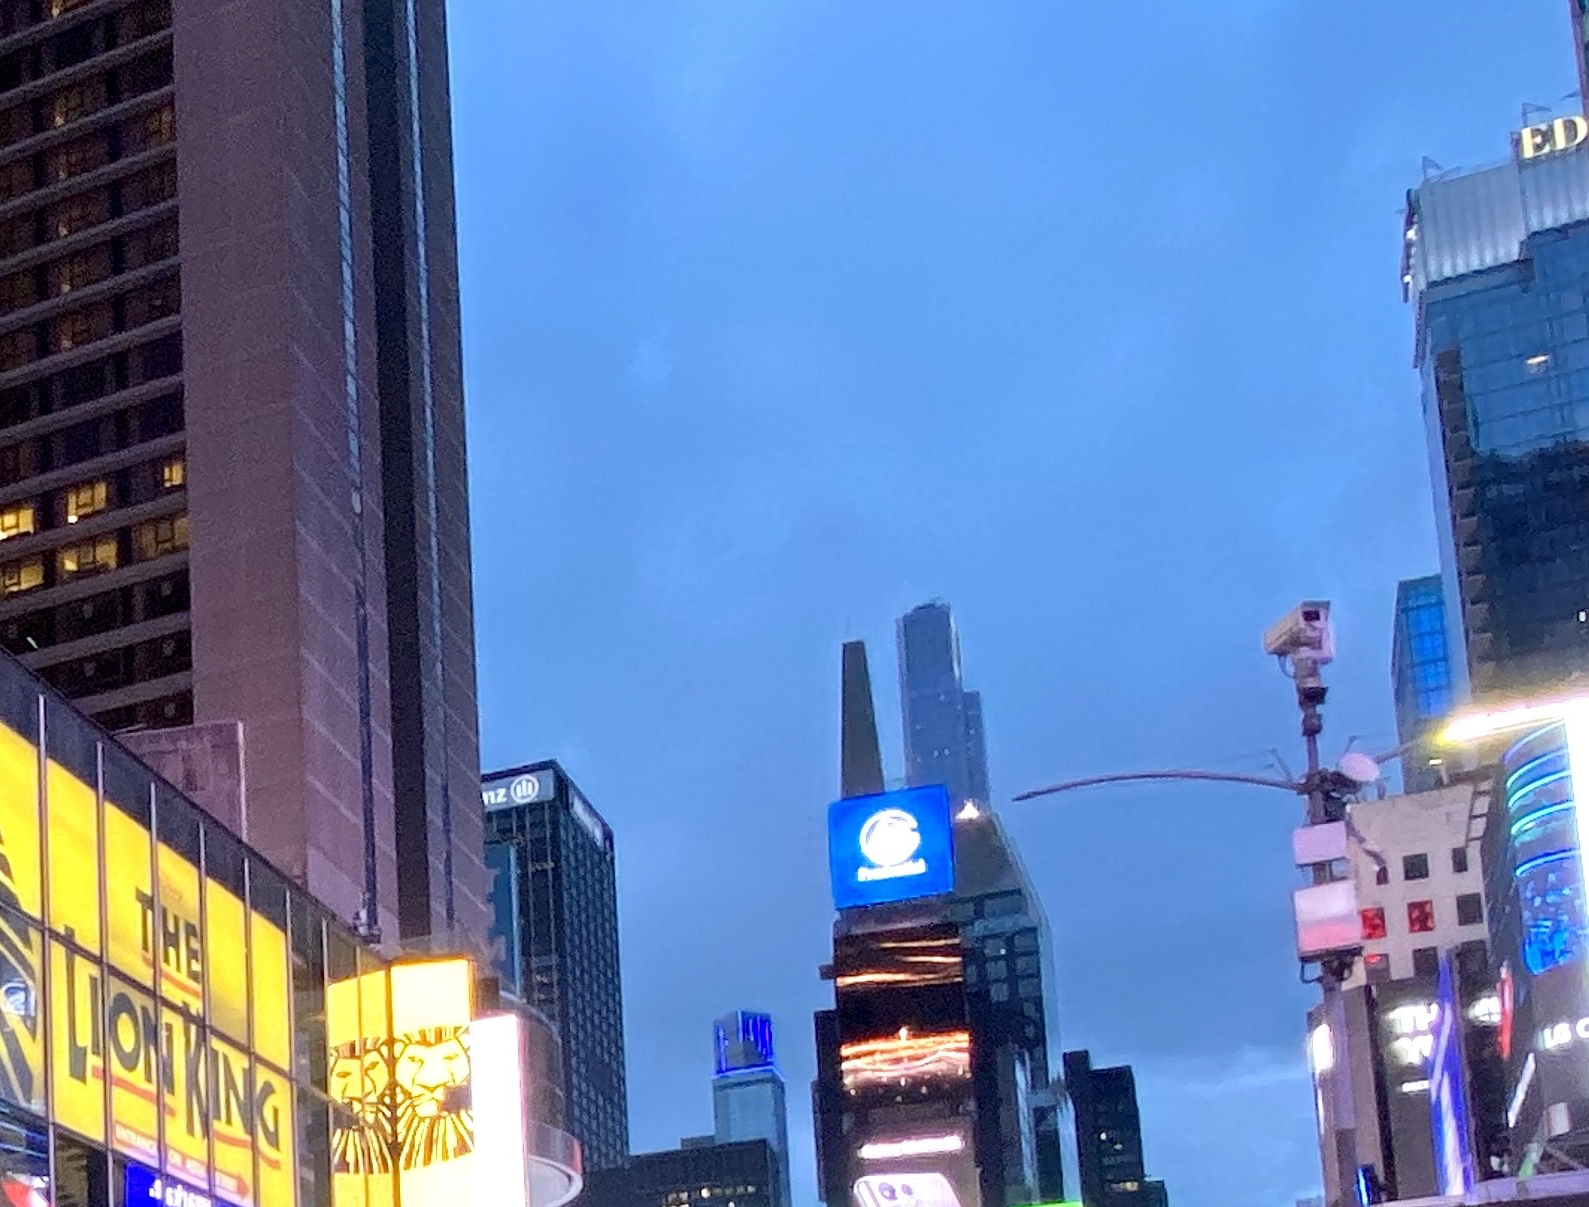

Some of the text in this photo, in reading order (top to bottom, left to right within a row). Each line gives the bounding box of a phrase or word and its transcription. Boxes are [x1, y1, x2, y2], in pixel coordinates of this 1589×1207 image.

[64, 924, 175, 1096] LION
[135, 886, 202, 985] THE
[181, 1000, 281, 1152] KING
